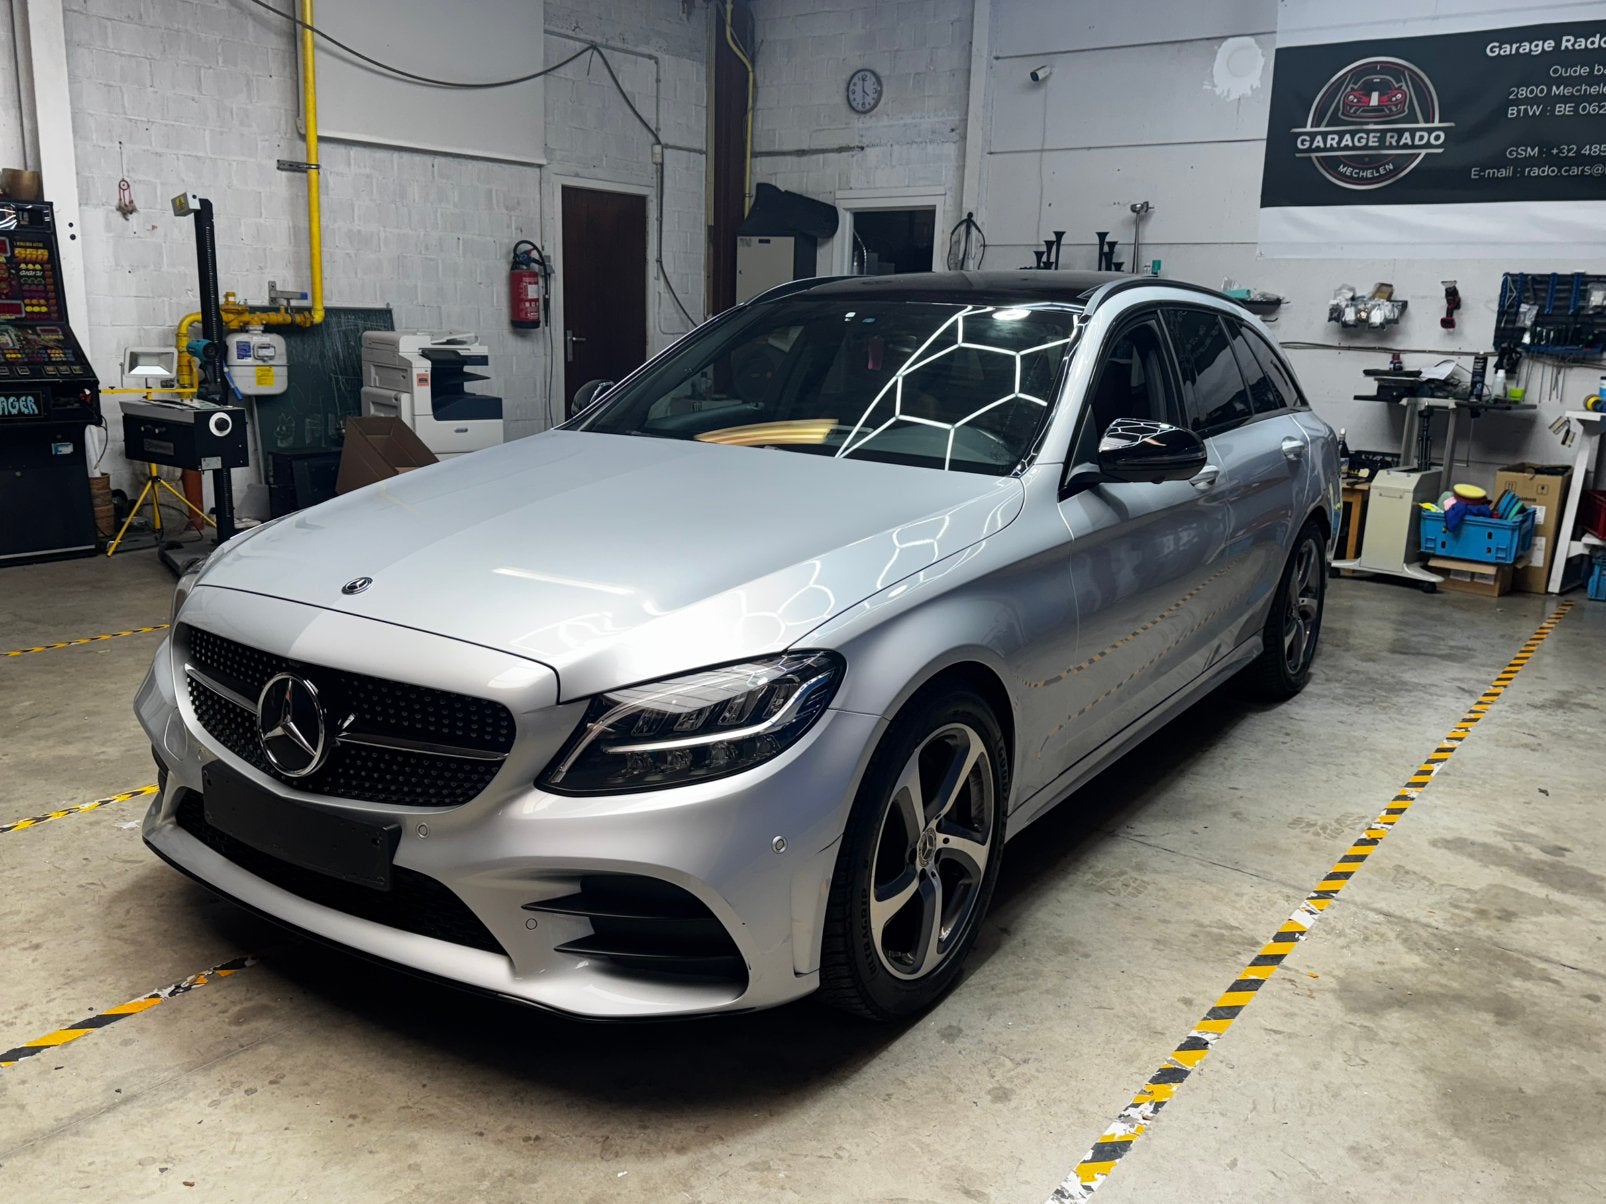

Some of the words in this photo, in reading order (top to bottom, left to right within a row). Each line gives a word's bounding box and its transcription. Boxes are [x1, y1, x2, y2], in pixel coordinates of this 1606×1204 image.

[1486, 39, 1555, 57] Garage
[1549, 64, 1590, 77] Oude
[1508, 85, 1547, 99] 2800
[1507, 104, 1543, 118] BTW
[1546, 106, 1551, 116] :
[1555, 103, 1575, 115] BE
[1579, 102, 1606, 115] 062
[1296, 132, 1381, 150] GARAGE
[1385, 130, 1446, 146] RADO
[1506, 146, 1539, 158] GSM
[1551, 145, 1577, 157] +32
[1581, 144, 1606, 156] 485
[1337, 162, 1395, 178] MECHELEN
[1470, 165, 1514, 179] E-mail
